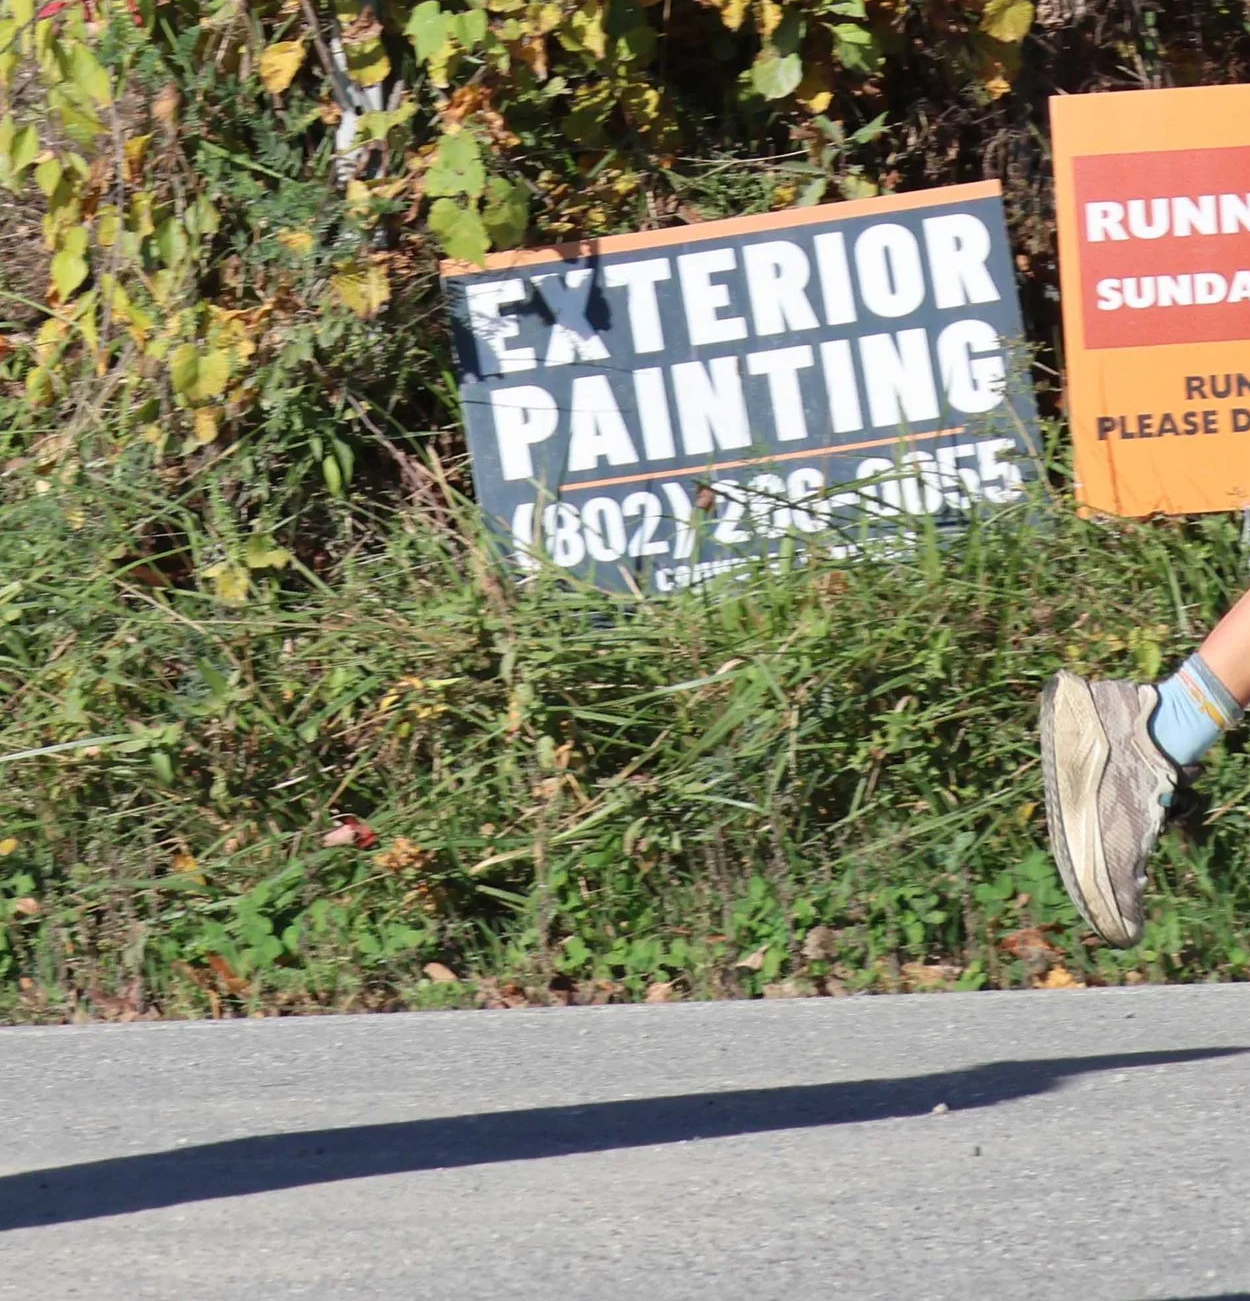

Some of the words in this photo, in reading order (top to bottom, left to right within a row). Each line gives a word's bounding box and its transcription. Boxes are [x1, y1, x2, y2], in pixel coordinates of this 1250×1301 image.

[465, 212, 1001, 373] EXTERIOR
[490, 319, 1006, 481] PAINTING
[1096, 410, 1219, 441] PLEASE
